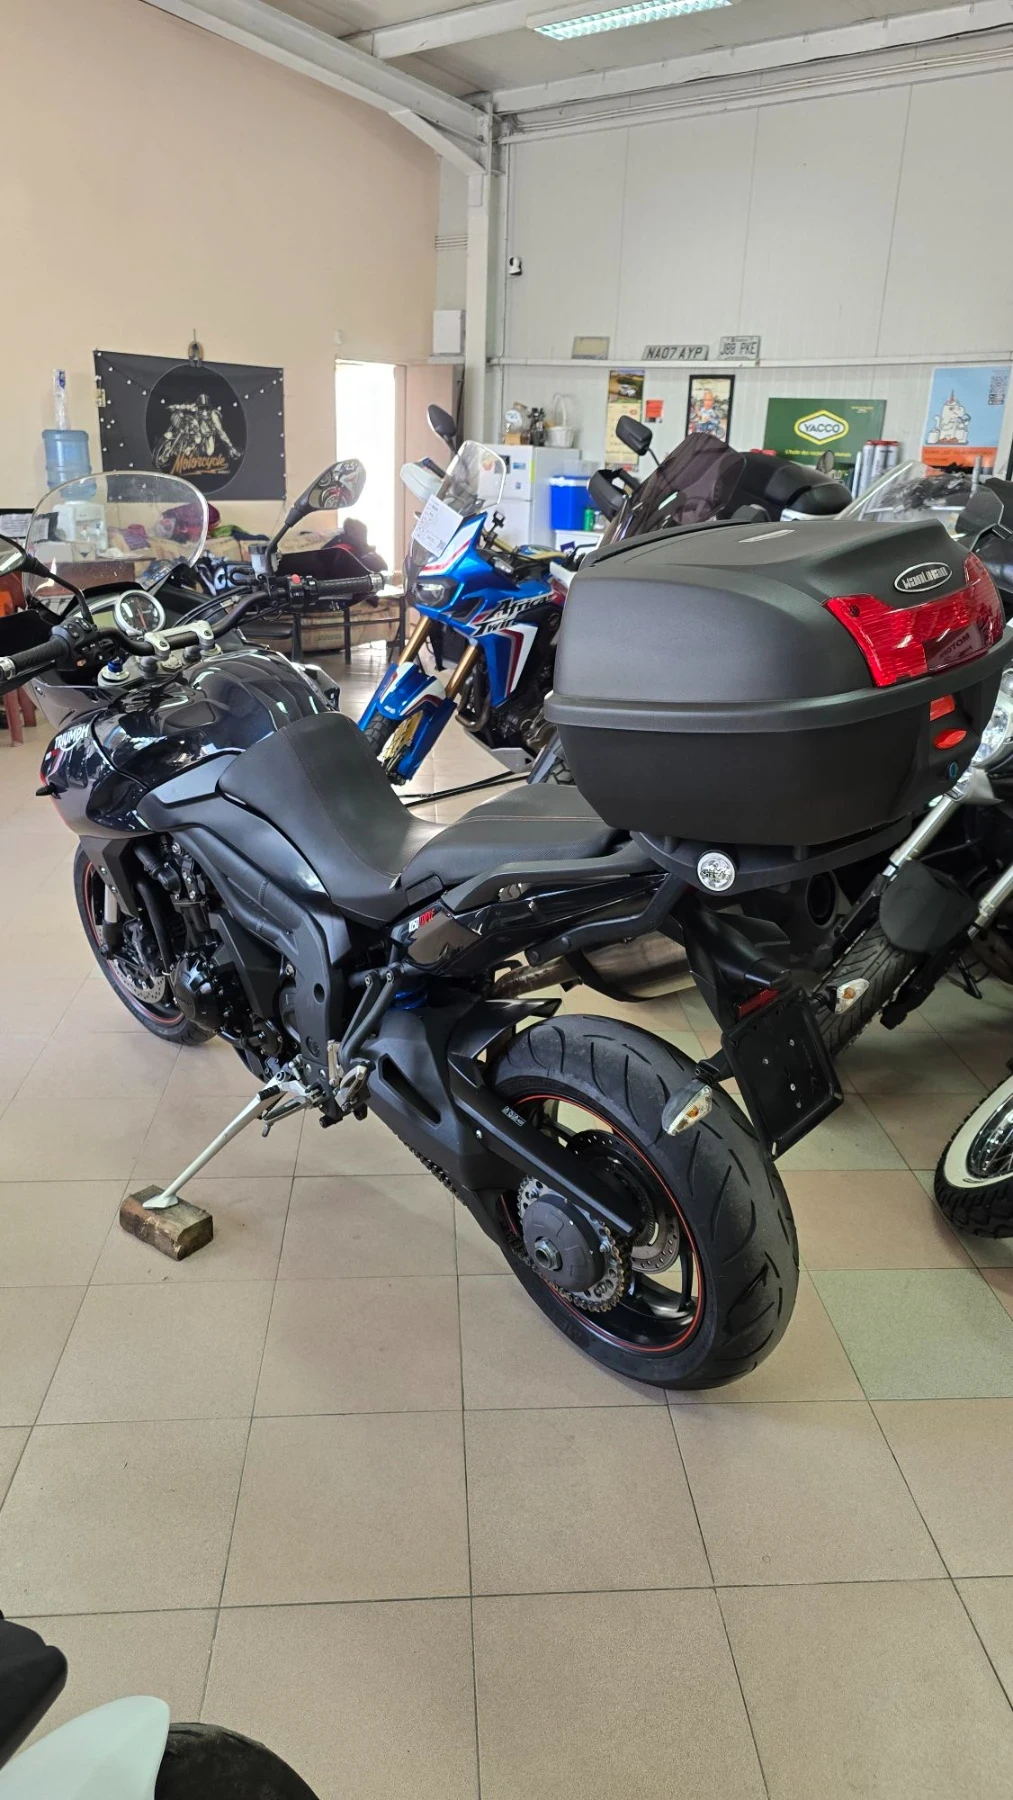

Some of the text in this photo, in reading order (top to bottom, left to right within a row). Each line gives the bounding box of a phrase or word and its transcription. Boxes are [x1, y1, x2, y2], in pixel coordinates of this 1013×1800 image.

[678, 346, 704, 359] AYP
[803, 423, 841, 434] YACCO
[170, 453, 228, 475] Motorcycle
[54, 723, 90, 751] TRIUMPH
